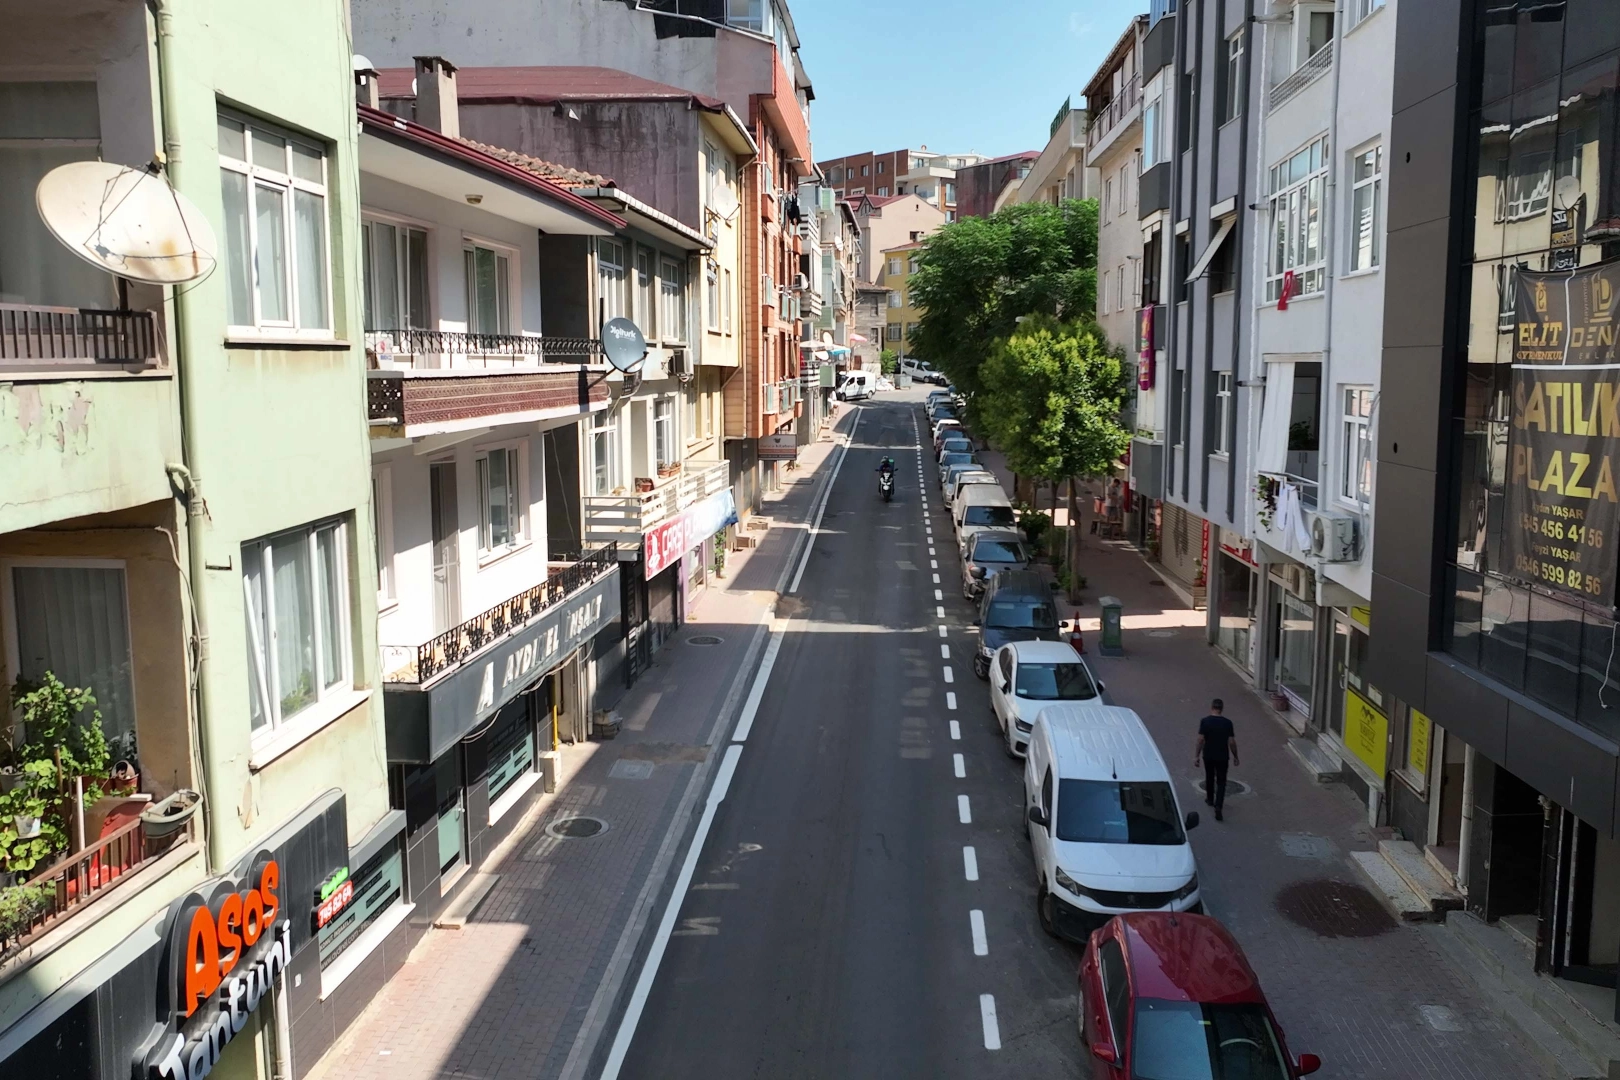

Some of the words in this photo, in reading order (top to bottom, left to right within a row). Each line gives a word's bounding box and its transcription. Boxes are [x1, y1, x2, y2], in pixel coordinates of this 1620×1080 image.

[1518, 315, 1563, 347] ELİT
[1514, 381, 1620, 438] SATILIK
[1511, 443, 1618, 503] PLAZA
[1551, 504, 1584, 520] YAŞAR
[1540, 519, 1564, 540] 456
[1567, 524, 1586, 544] 41
[1587, 528, 1604, 549] 56
[1550, 545, 1582, 562] YAŞAR
[1515, 554, 1540, 577] 0546
[1541, 562, 1565, 584] 599
[1567, 569, 1582, 590] 82
[1585, 574, 1601, 596] 56
